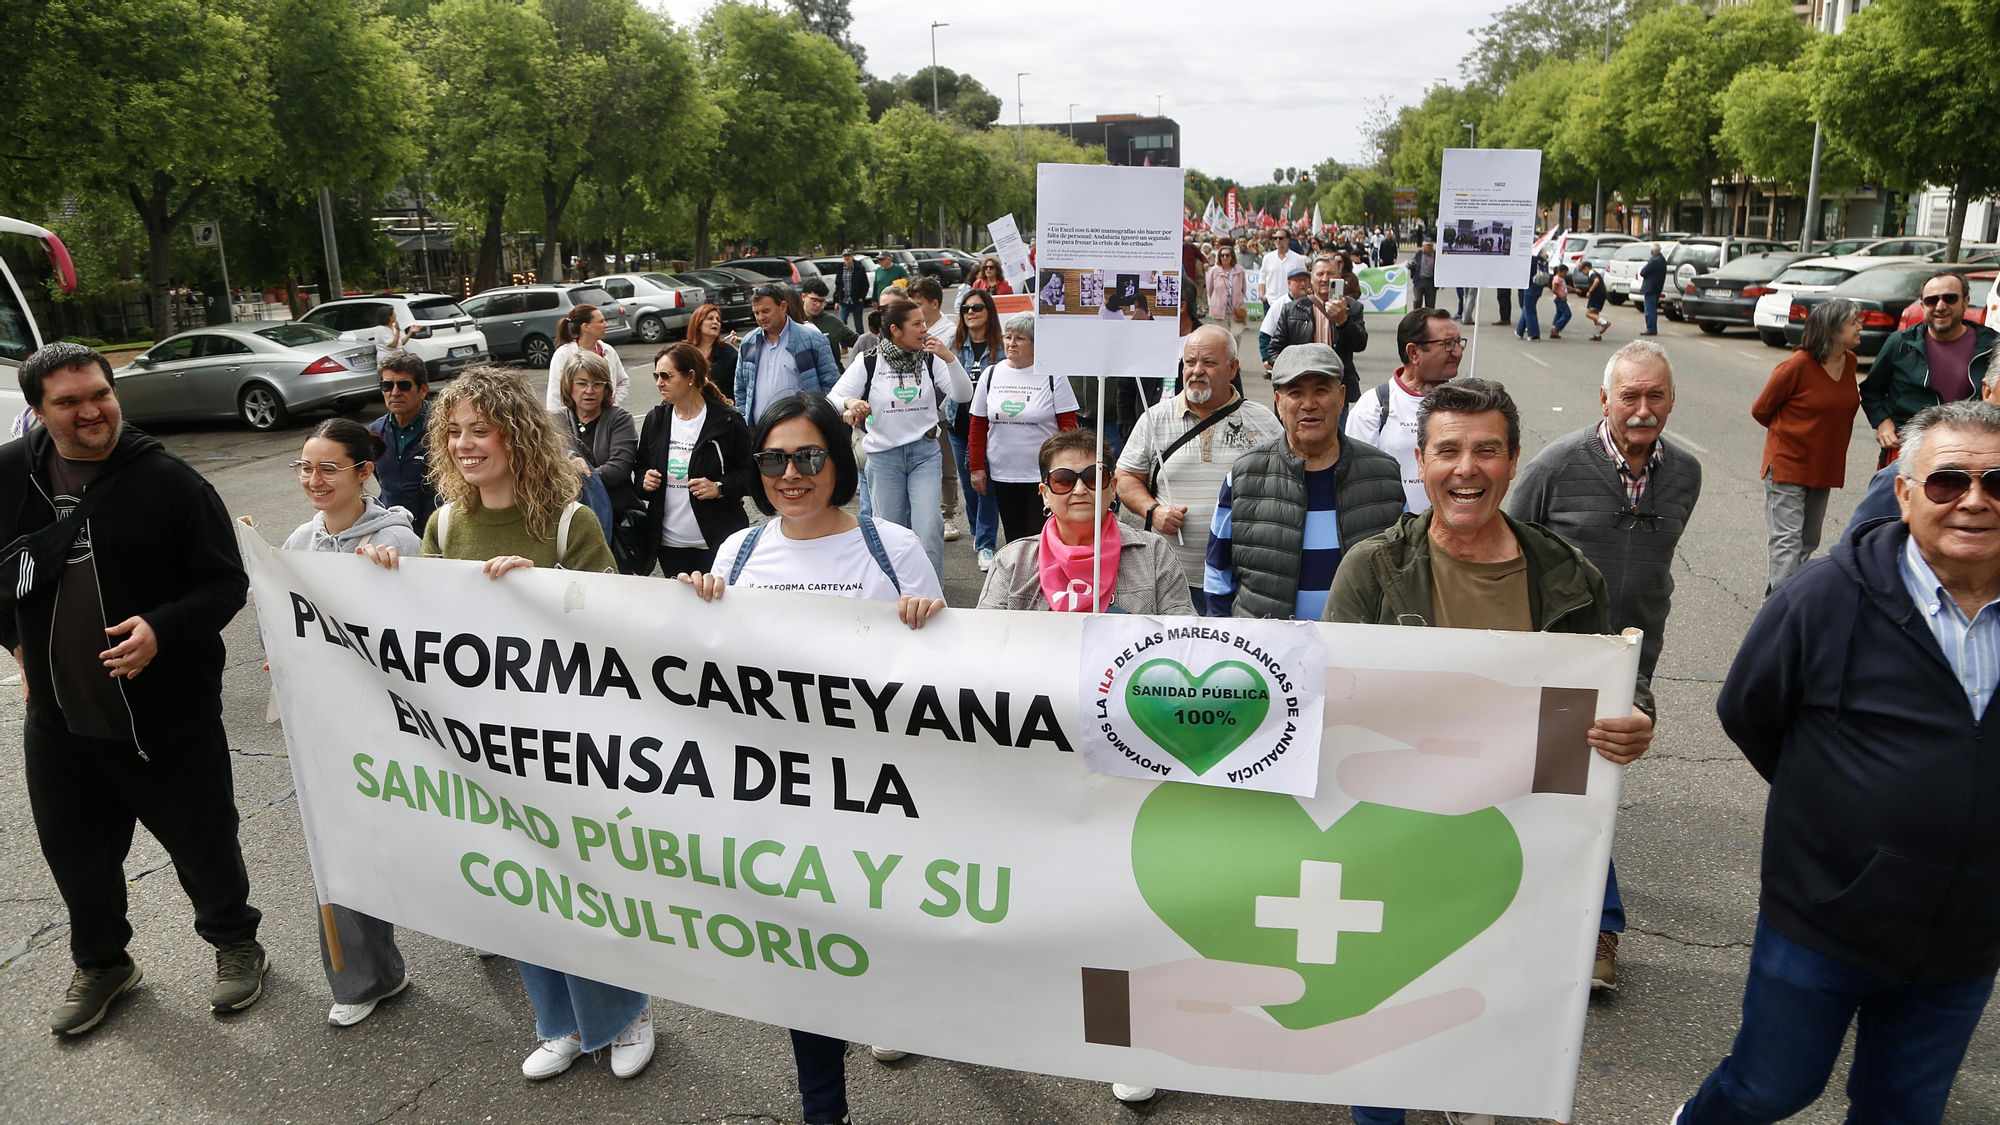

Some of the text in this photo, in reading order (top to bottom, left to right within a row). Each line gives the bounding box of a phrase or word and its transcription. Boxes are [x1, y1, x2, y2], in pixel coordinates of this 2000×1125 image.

[208, 296, 214, 306] P
[289, 592, 1074, 752] PLATAFORMA CARTEYANA
[1096, 627, 1299, 783] APOYAMOS LA ILP DE LAS MAREAS BLANCAS DE ANDALUCÍA
[1132, 685, 1269, 700] SANIDAD PÚBLICA
[1174, 710, 1236, 725] 100%
[388, 690, 920, 818] EN DEFENSA DE LA
[353, 753, 1011, 924] SANIDAD PÚBLICA Y SU
[460, 852, 870, 977] CONSULTORIO
